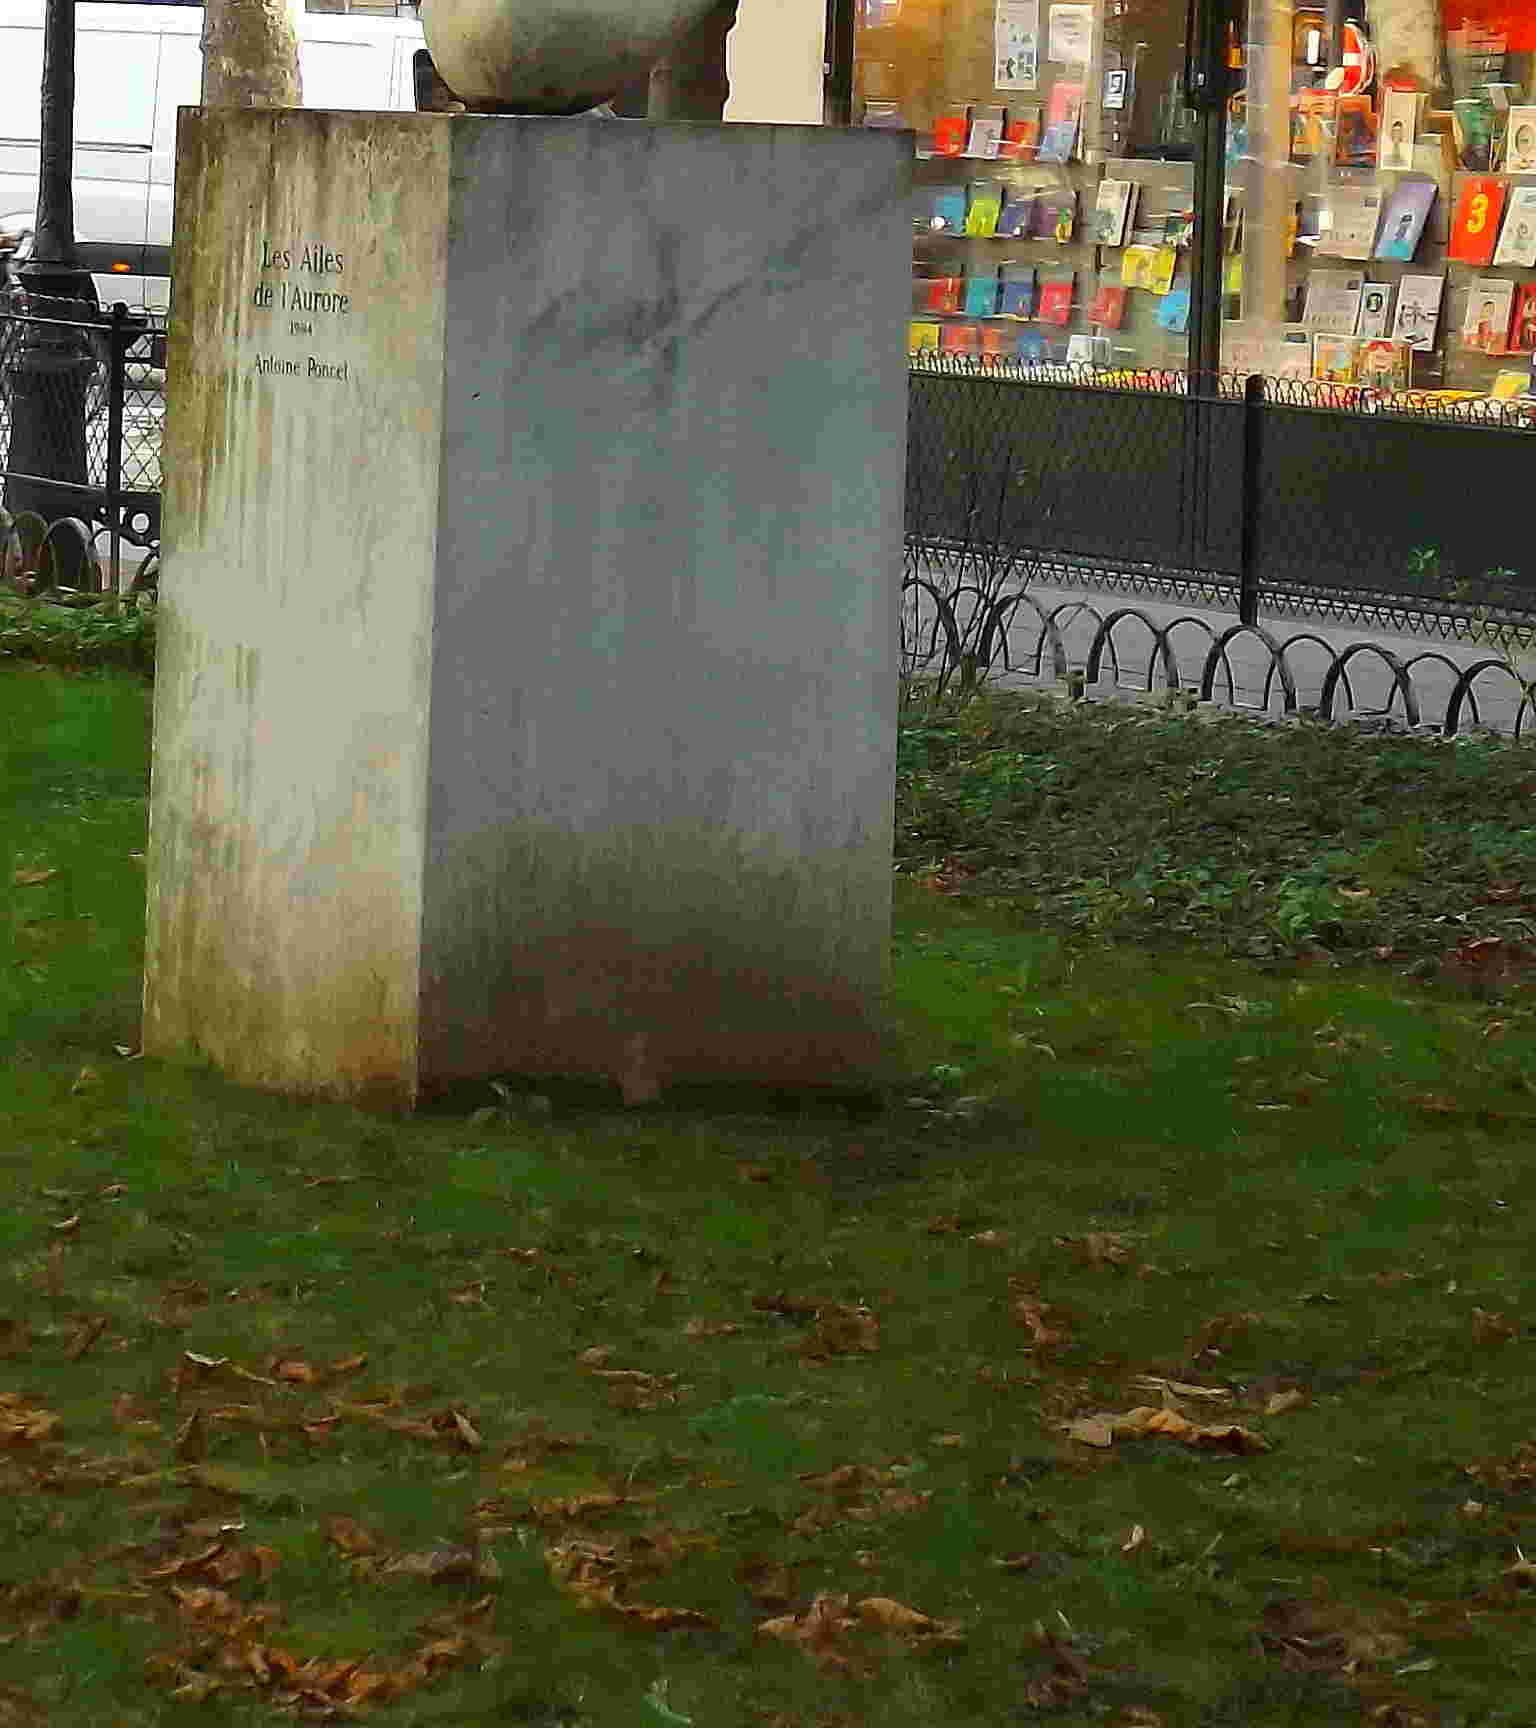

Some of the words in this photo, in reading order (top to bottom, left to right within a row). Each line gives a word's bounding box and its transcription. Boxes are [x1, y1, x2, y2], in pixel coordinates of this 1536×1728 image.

[262, 239, 290, 270] Les
[300, 243, 344, 274] Ailes
[254, 281, 273, 308] de
[255, 354, 300, 376] Antoine
